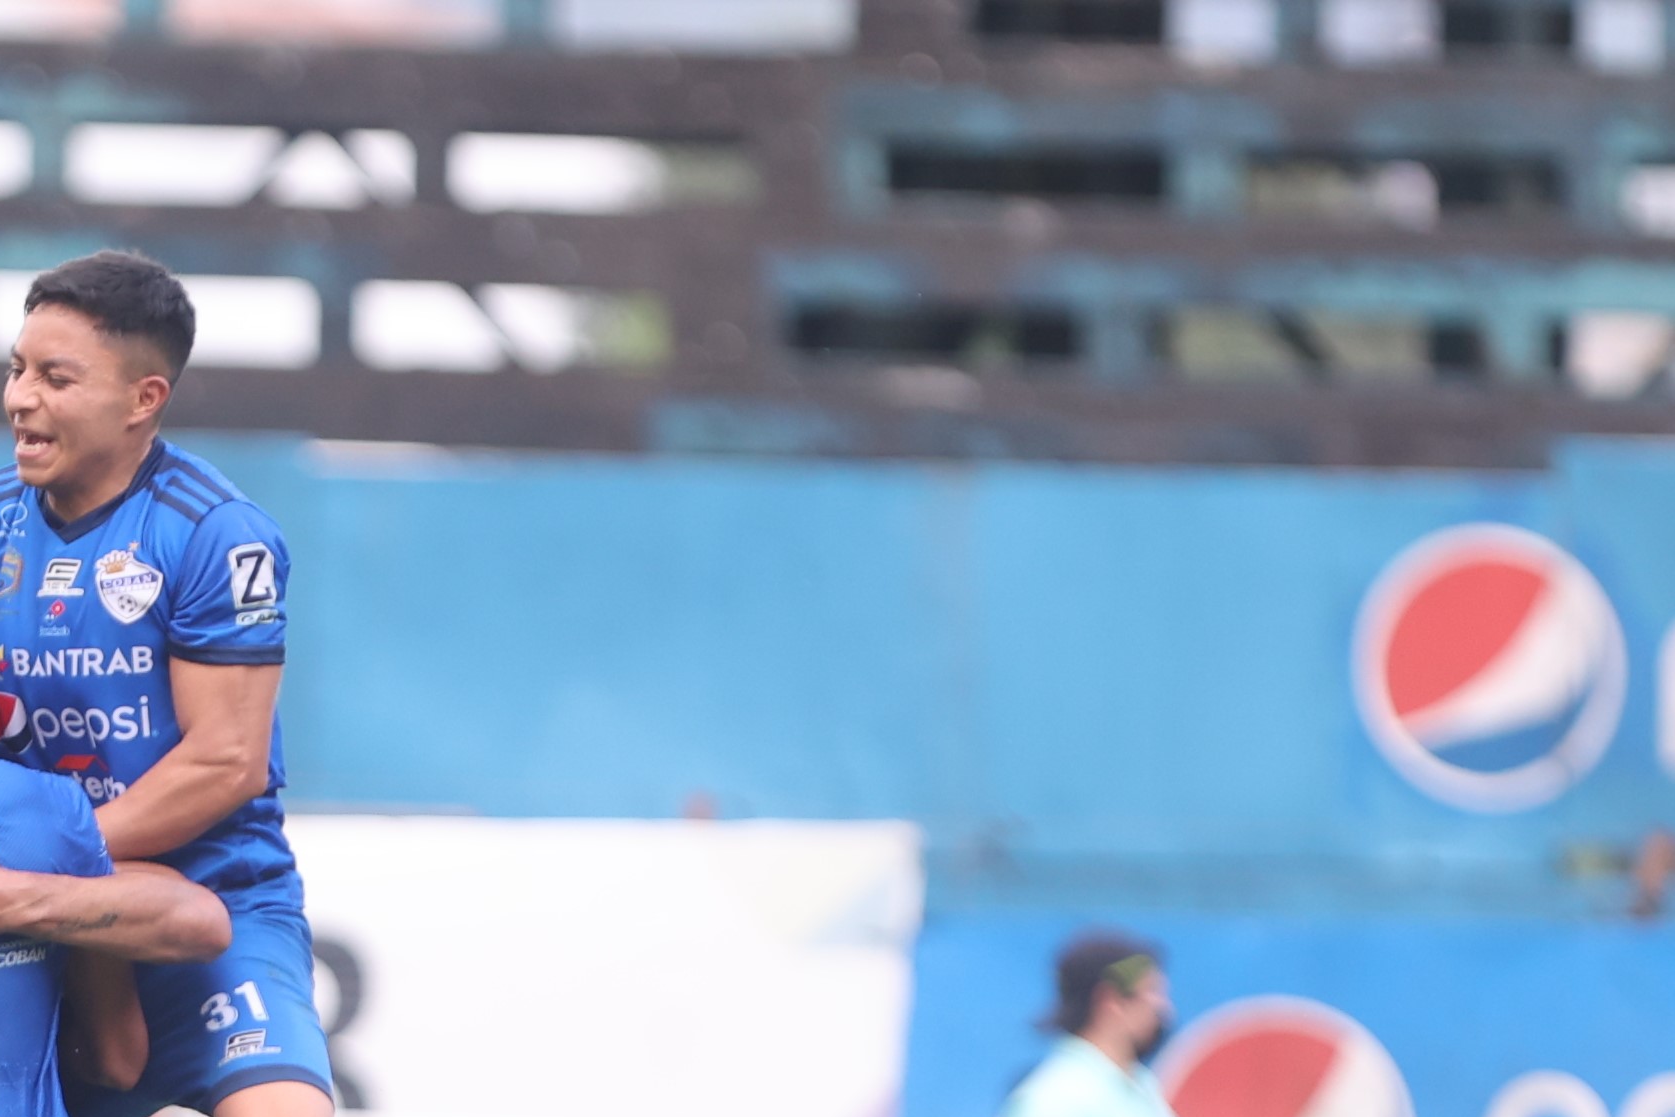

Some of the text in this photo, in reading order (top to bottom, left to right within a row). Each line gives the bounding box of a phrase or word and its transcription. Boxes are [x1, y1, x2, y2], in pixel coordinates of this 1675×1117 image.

[11, 646, 154, 677] BANTRAB
[33, 695, 151, 749] pepsi
[200, 980, 270, 1033] 31
